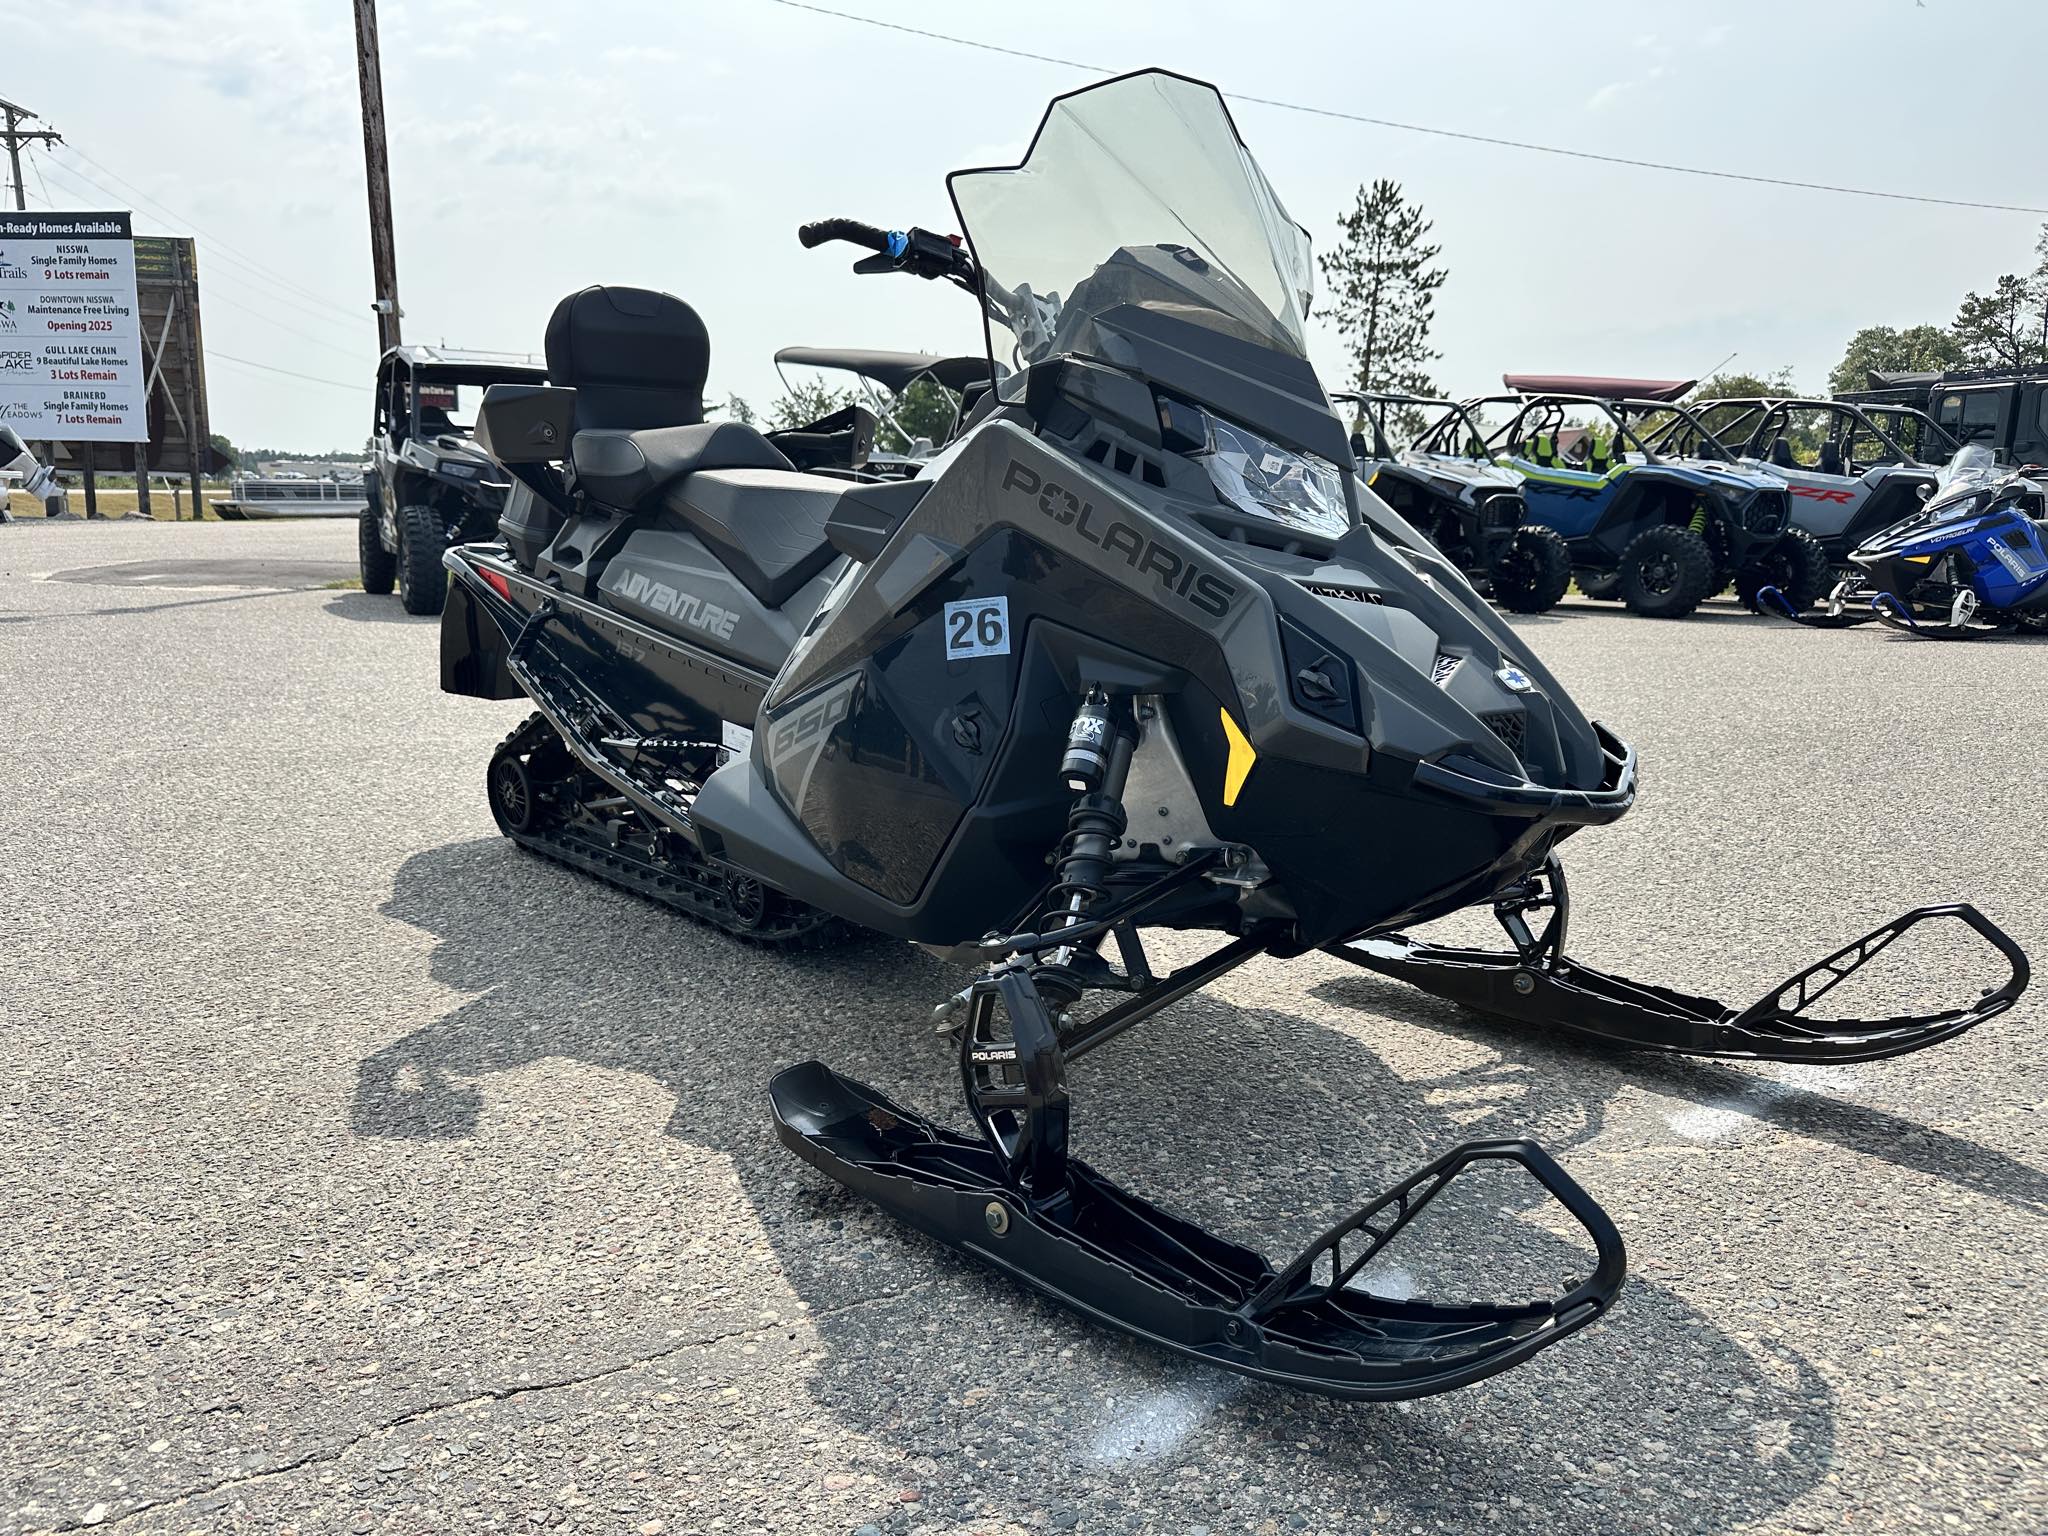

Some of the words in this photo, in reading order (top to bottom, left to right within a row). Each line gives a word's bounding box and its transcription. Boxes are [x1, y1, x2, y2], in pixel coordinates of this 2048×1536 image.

[39, 222, 73, 233] Homes
[74, 222, 121, 233] Available
[56, 245, 89, 253] NISSWA
[31, 256, 57, 267] Single
[59, 256, 87, 267] Family
[88, 256, 118, 265] Homes
[45, 270, 51, 279] 9
[54, 270, 73, 279] Lots
[76, 270, 110, 279] remain
[86, 296, 115, 304] NISSWA
[28, 305, 82, 314] Maintenance
[84, 305, 102, 314] Free
[103, 305, 129, 316] Living
[0, 320, 17, 328] WA
[48, 321, 86, 332] Opening
[88, 321, 113, 331] 2025
[45, 346, 66, 354] GULL
[68, 346, 89, 354] LAKE
[91, 346, 117, 355] CHAIN
[36, 357, 41, 365] 9
[43, 357, 79, 365] Beautiful
[81, 357, 99, 365] Lake
[101, 358, 128, 366] Homes
[51, 370, 57, 379] 3
[59, 370, 78, 380] Lots
[80, 370, 117, 380] Remain
[64, 391, 106, 400] BRAINERD
[44, 402, 69, 412] Single
[71, 402, 98, 412] Family
[100, 402, 128, 411] Homes
[56, 415, 62, 424] 7
[65, 415, 84, 424] Lots
[86, 415, 122, 424] Remain
[1001, 459, 1238, 618] POLARIS
[1930, 527, 1974, 544] VOYAGEUR
[1986, 537, 2026, 578] POLARIS
[612, 568, 740, 640] ADVENTURE
[949, 608, 1003, 650] 26
[774, 689, 851, 759] 650
[972, 1050, 1017, 1061] POLARIS
